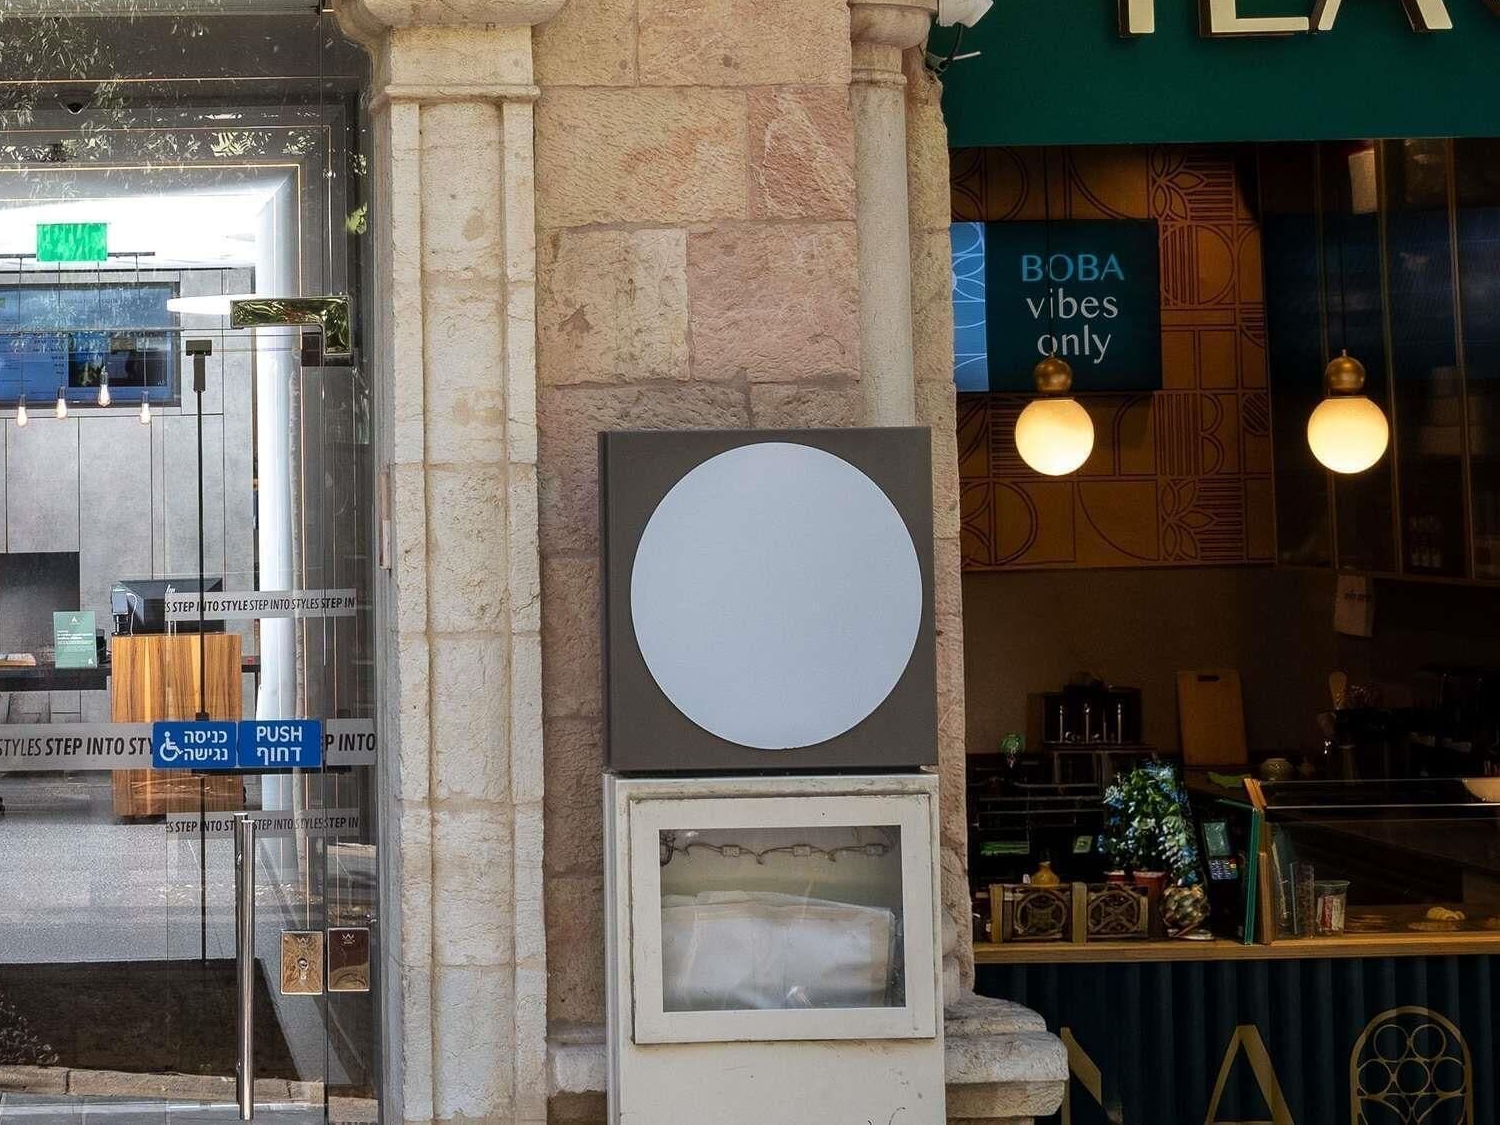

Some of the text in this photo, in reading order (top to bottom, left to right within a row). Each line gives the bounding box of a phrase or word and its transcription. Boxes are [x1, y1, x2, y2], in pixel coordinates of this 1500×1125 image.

[1021, 253, 1125, 282] BOBA
[1026, 287, 1119, 319] vibes
[1037, 324, 1112, 364] only
[172, 601, 195, 613] STEP
[221, 599, 248, 611] STYLE
[249, 599, 269, 611] STEP
[270, 598, 290, 610] INTO
[291, 598, 319, 610] STYLES
[320, 597, 343, 609] STEP
[183, 730, 228, 744] כניסה
[256, 725, 303, 742] PUSH
[338, 732, 376, 751] INTO
[45, 737, 83, 756] STEP
[86, 737, 124, 756] INTO
[183, 747, 229, 762] נגישה
[256, 746, 303, 766] דחוף
[175, 820, 198, 832] STEP
[200, 820, 222, 832] NTO
[252, 818, 273, 831] STEP
[273, 818, 294, 830] INTO
[323, 817, 347, 829] STEP
